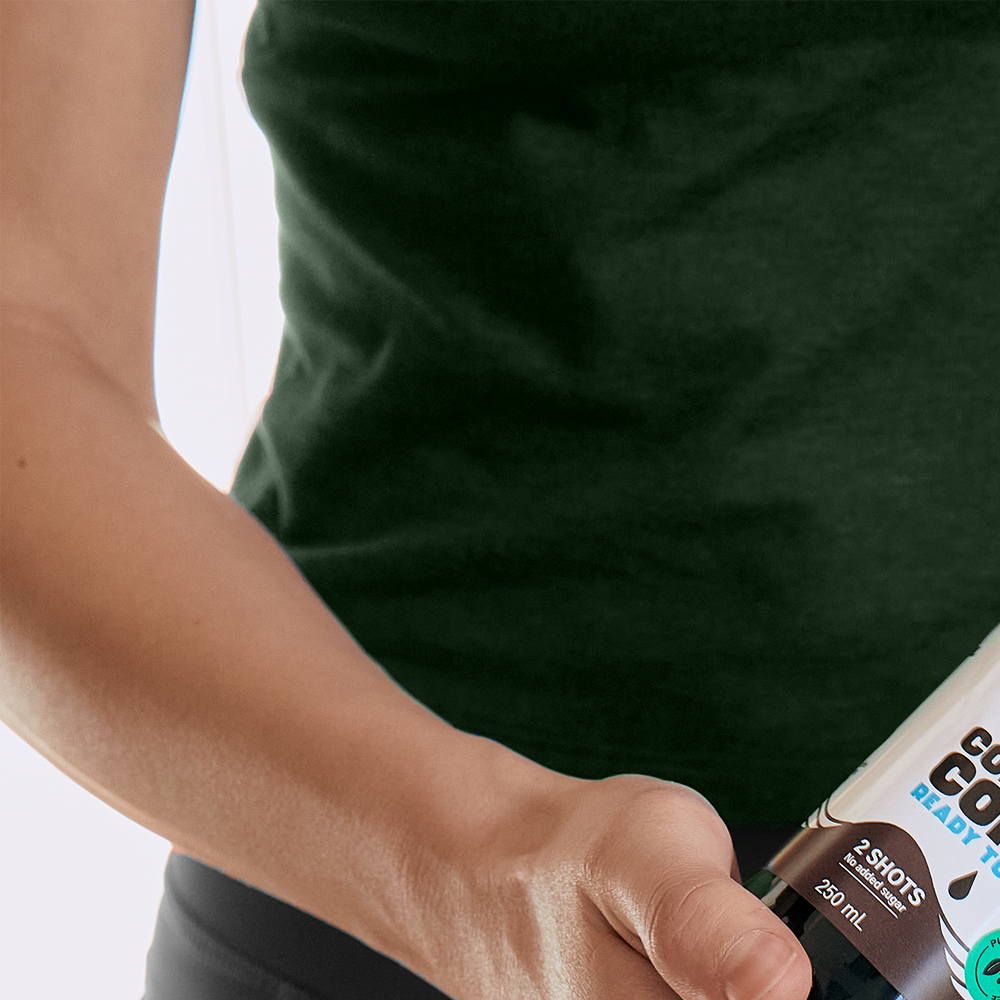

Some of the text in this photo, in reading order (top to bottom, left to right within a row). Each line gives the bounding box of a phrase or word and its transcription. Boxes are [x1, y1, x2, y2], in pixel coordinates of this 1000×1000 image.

[910, 782, 981, 845] READY
[843, 852, 907, 913] No added sugar
[853, 839, 926, 907] 2 SHOTS
[814, 879, 867, 932] 250 mL
